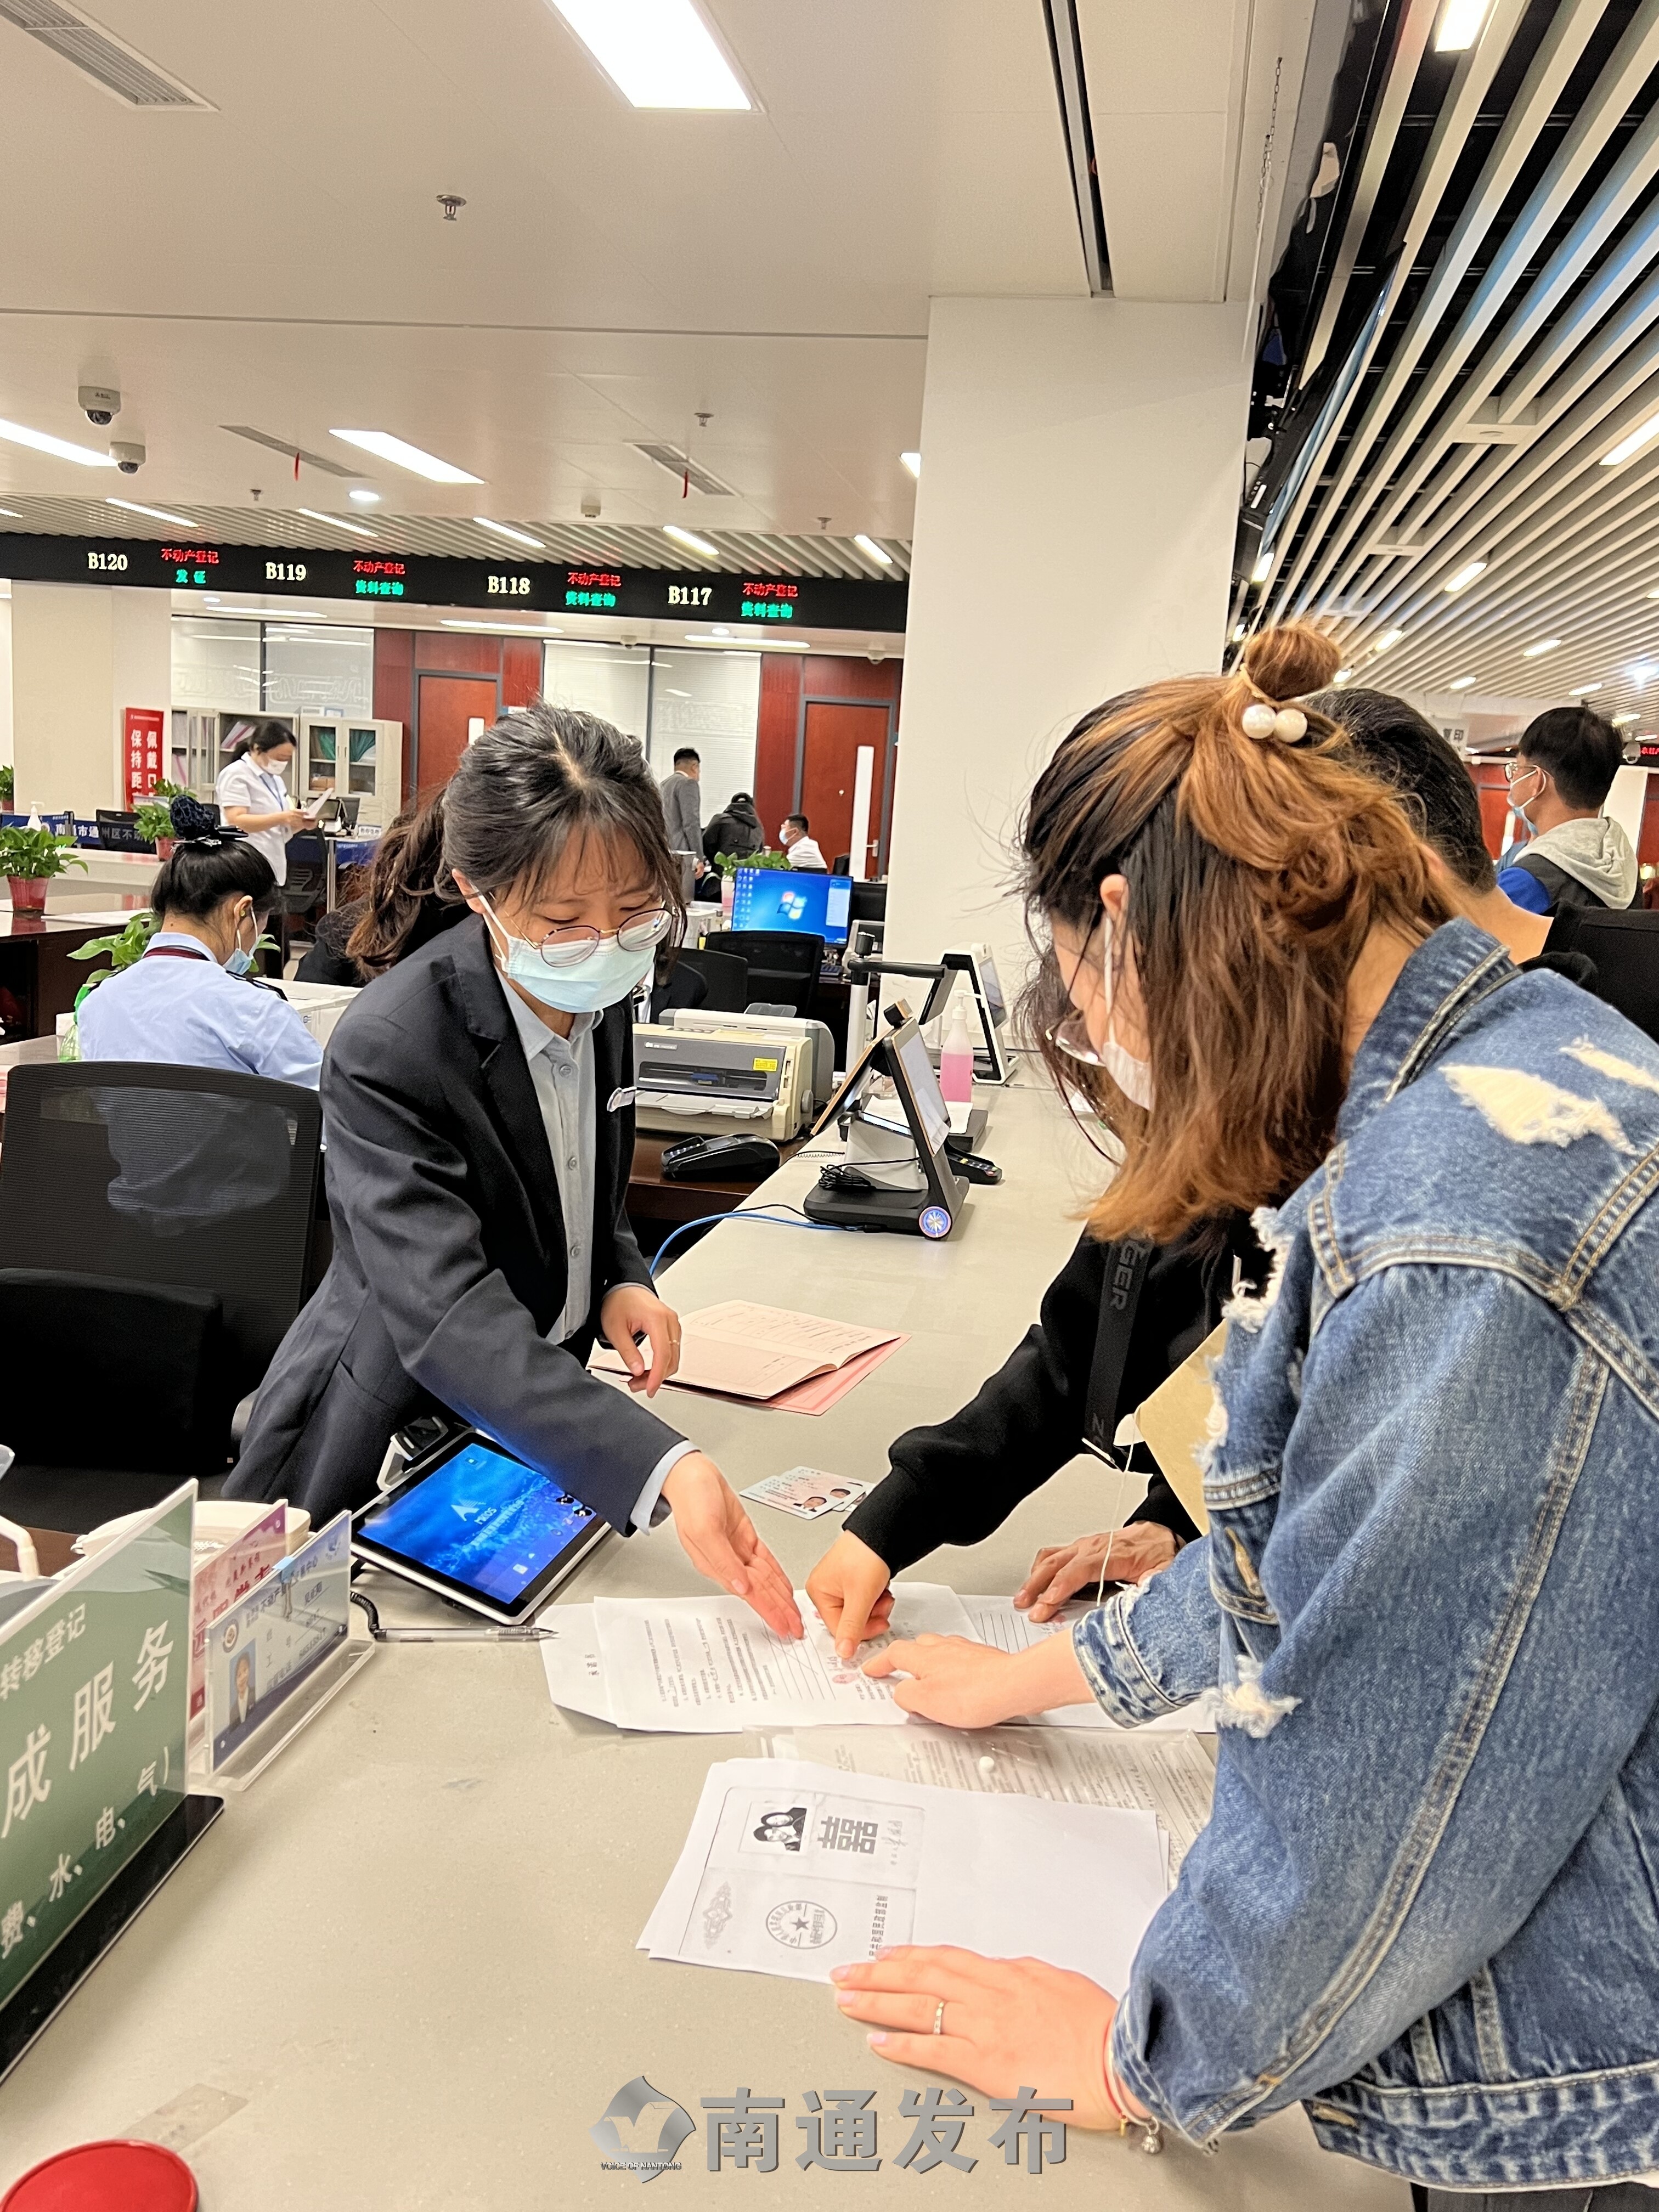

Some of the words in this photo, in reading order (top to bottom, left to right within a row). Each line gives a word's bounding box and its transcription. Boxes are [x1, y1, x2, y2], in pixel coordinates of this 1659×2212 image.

[88, 552, 128, 571] B120
[161, 549, 219, 563] 不动产登记
[266, 562, 306, 581] B119
[353, 560, 405, 574] 不动产登记
[488, 575, 531, 595] B118
[567, 572, 622, 586] 不动产登记
[668, 586, 712, 606] B117
[742, 583, 798, 597] 不动产登记
[131, 729, 143, 796] 保持距
[146, 731, 157, 797] 佩戴口
[0, 1602, 86, 1700] 转移登记
